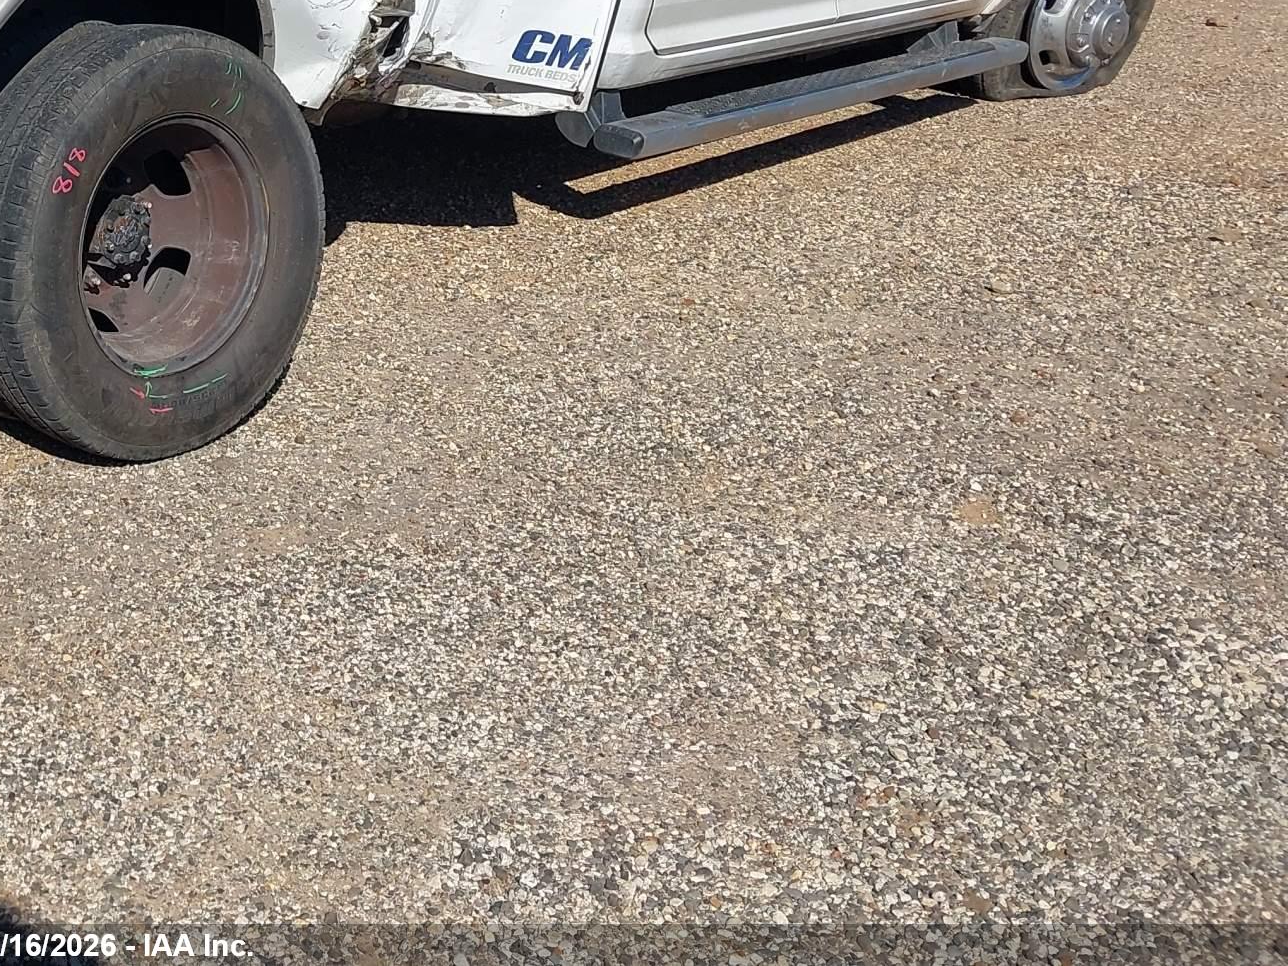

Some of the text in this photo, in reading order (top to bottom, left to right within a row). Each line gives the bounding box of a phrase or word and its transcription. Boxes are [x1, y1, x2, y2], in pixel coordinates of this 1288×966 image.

[511, 29, 592, 71] CM
[506, 64, 578, 83] TRUCK BEDS
[52, 147, 86, 194] 818
